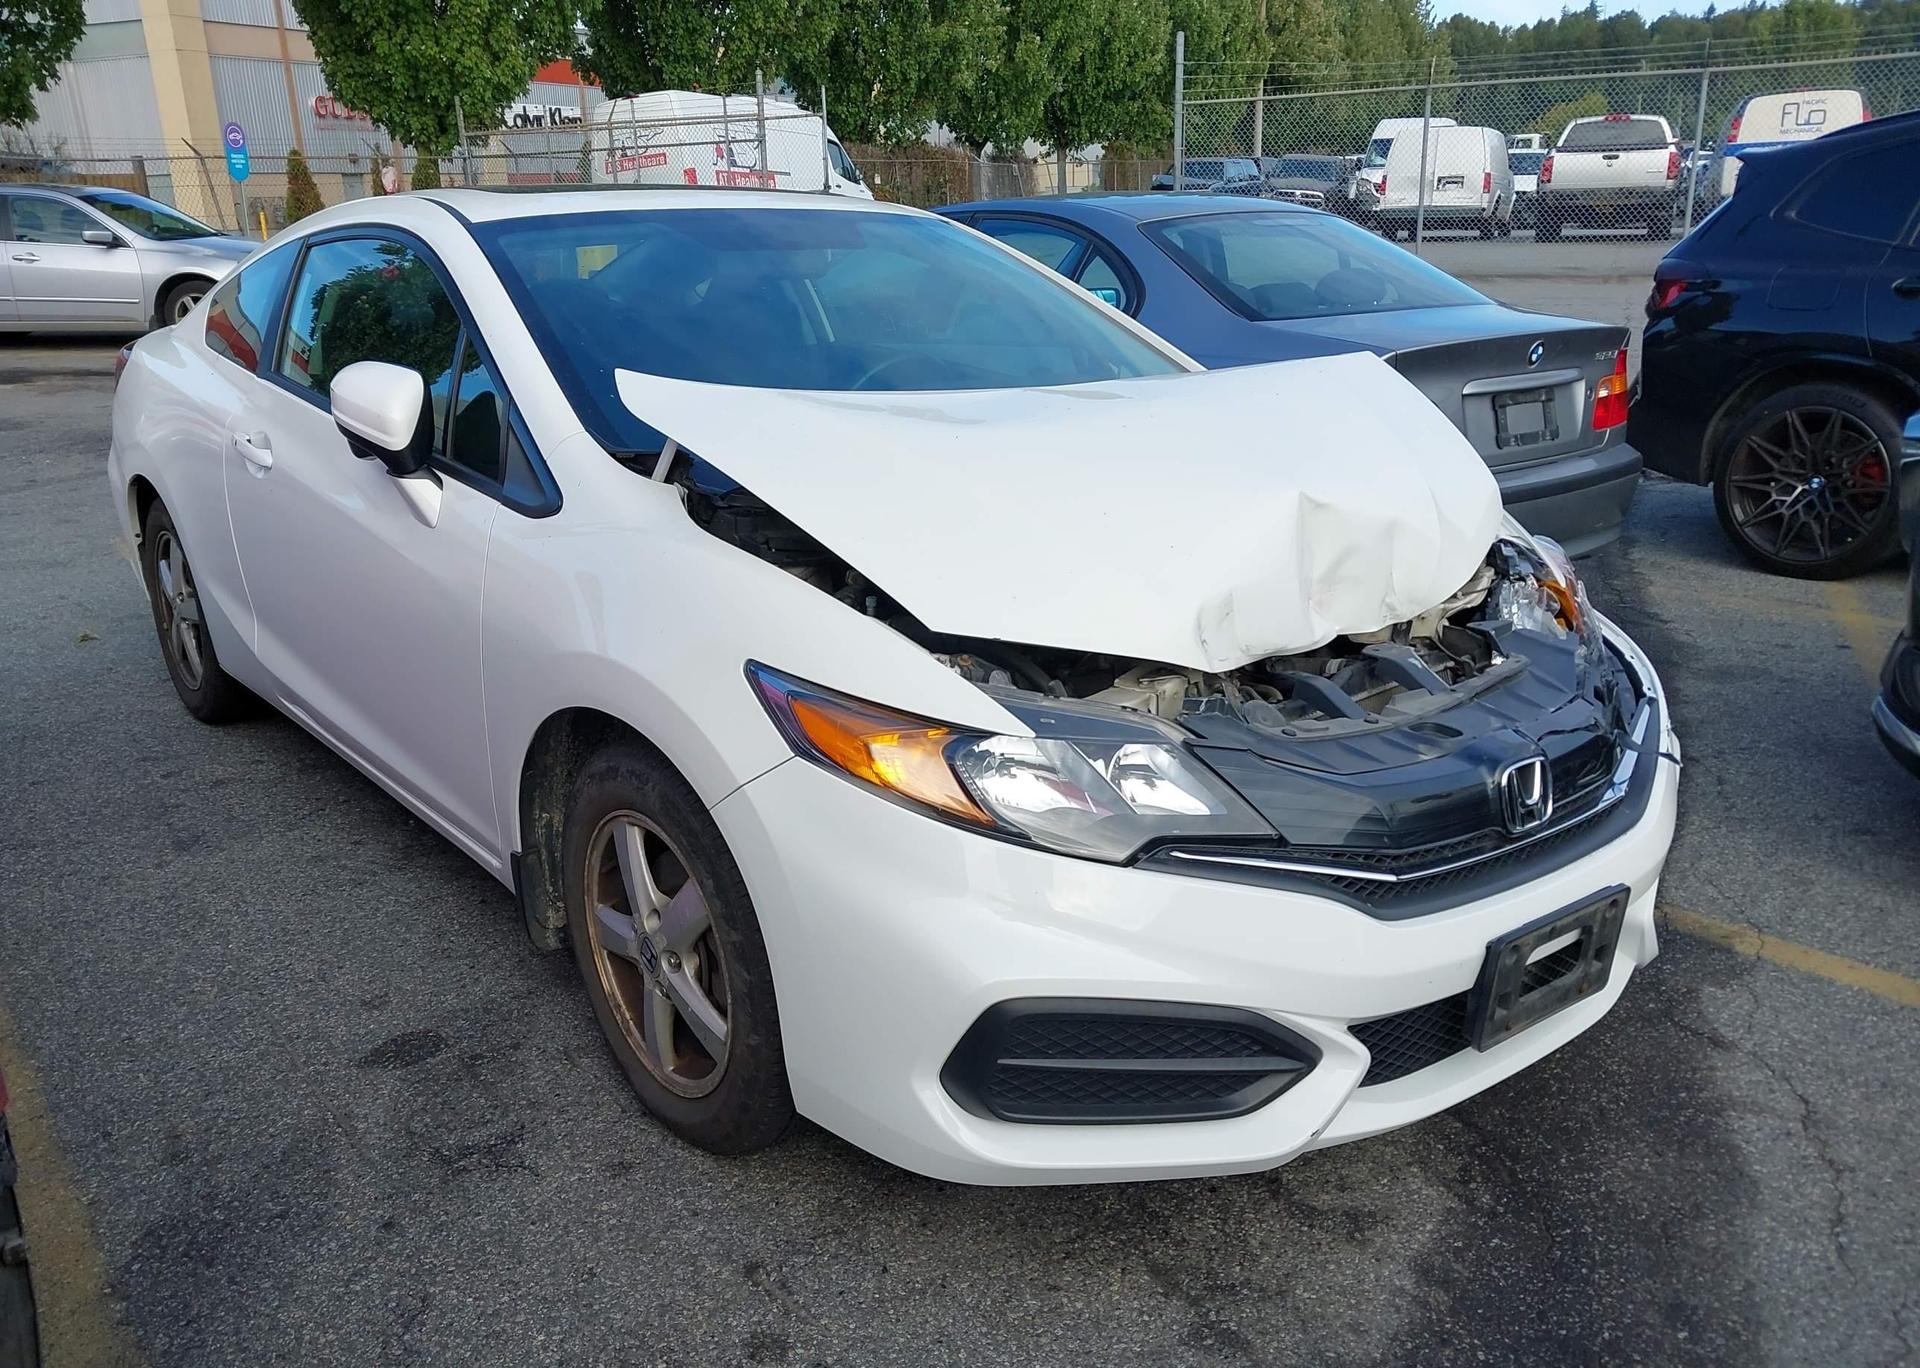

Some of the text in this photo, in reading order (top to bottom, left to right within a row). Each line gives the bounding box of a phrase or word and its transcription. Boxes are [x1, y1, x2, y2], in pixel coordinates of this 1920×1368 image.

[606, 155, 665, 174] AS Hethcare
[736, 174, 776, 188] Healthre
